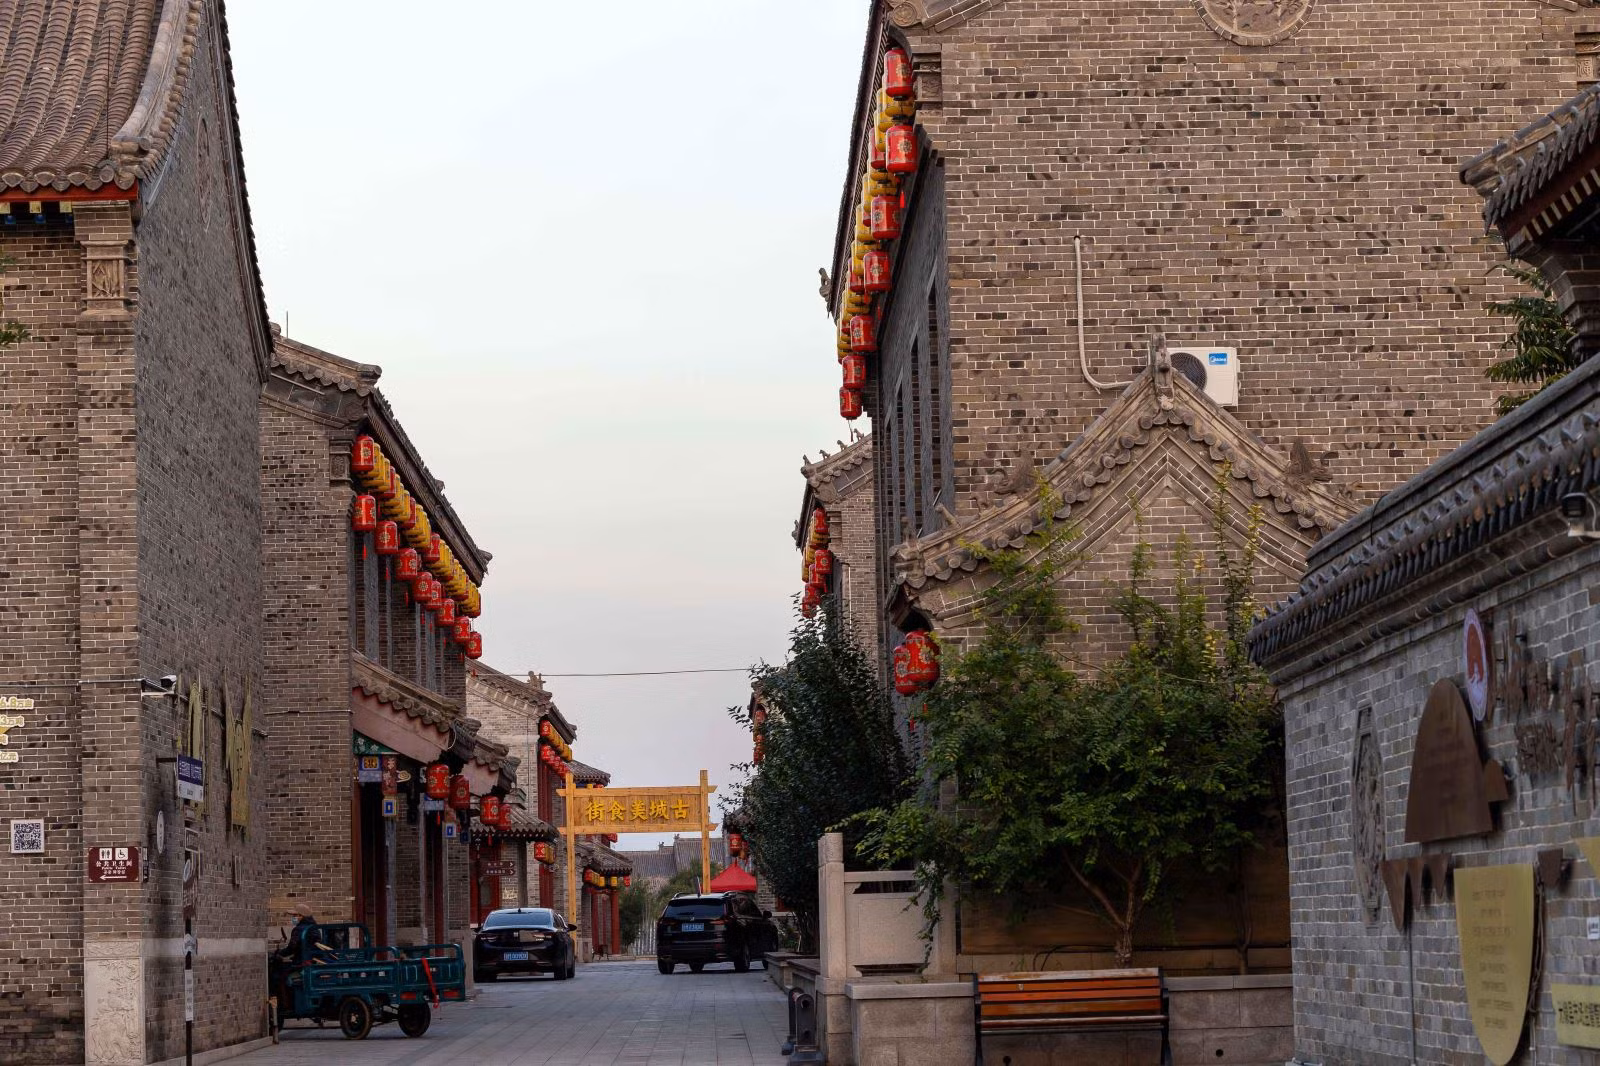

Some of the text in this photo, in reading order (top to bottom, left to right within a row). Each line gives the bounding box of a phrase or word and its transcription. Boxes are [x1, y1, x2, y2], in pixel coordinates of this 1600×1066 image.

[585, 799, 689, 822] 古城美食街
